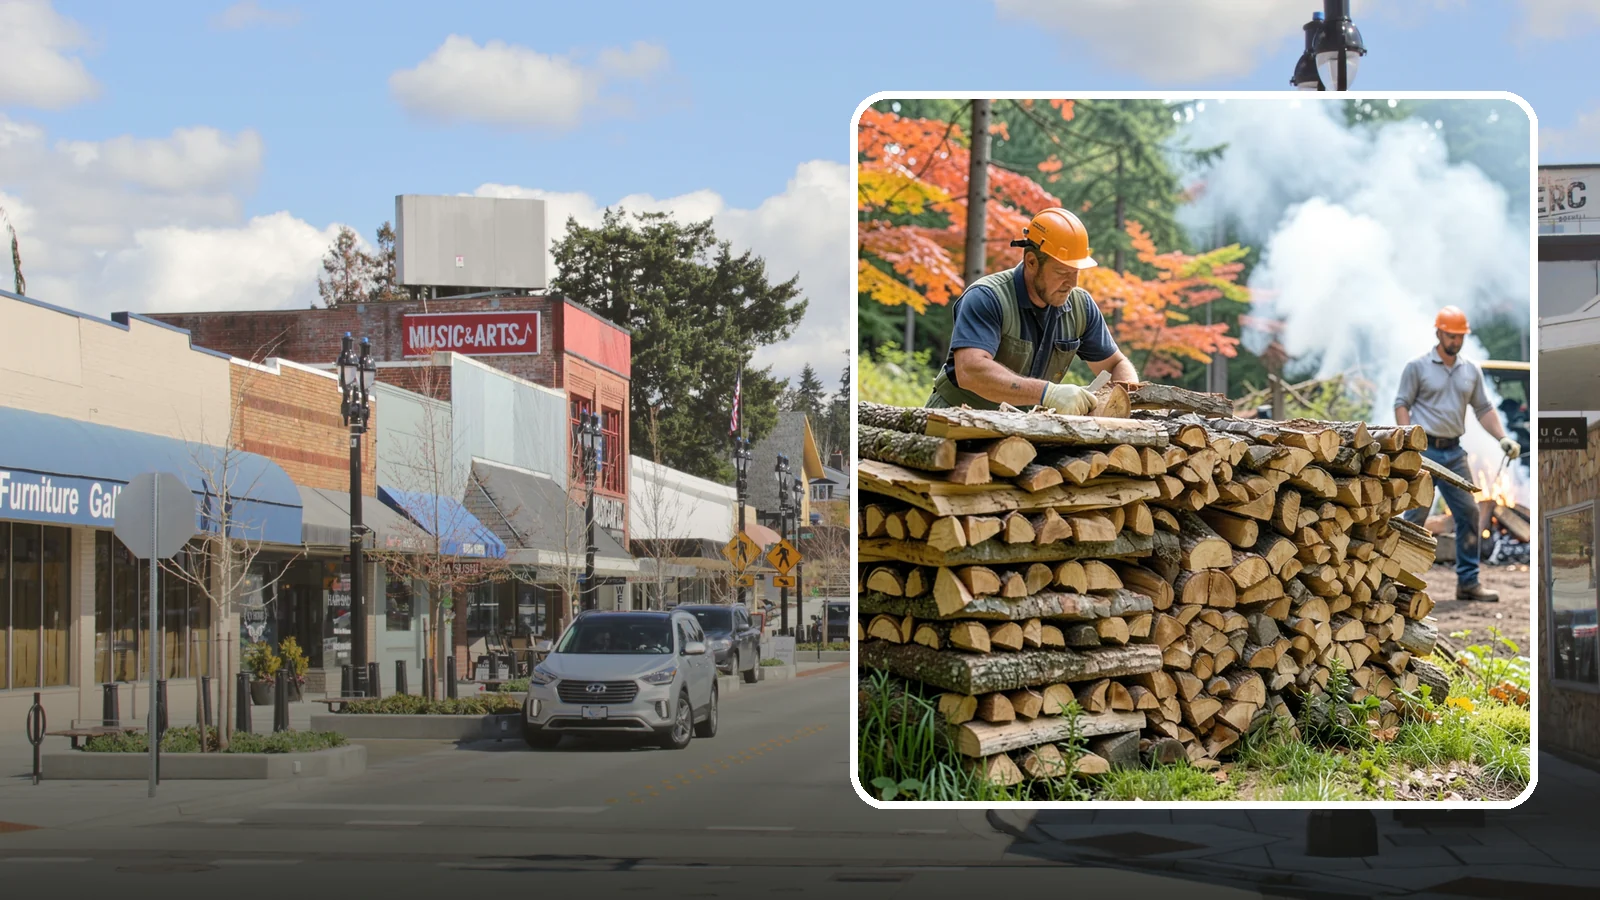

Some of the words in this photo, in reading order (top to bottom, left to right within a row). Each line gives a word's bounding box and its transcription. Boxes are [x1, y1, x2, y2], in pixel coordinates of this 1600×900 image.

[1540, 427, 1577, 436] UGA
[0, 471, 79, 515] Furniture
[453, 563, 479, 574] SUSHI
